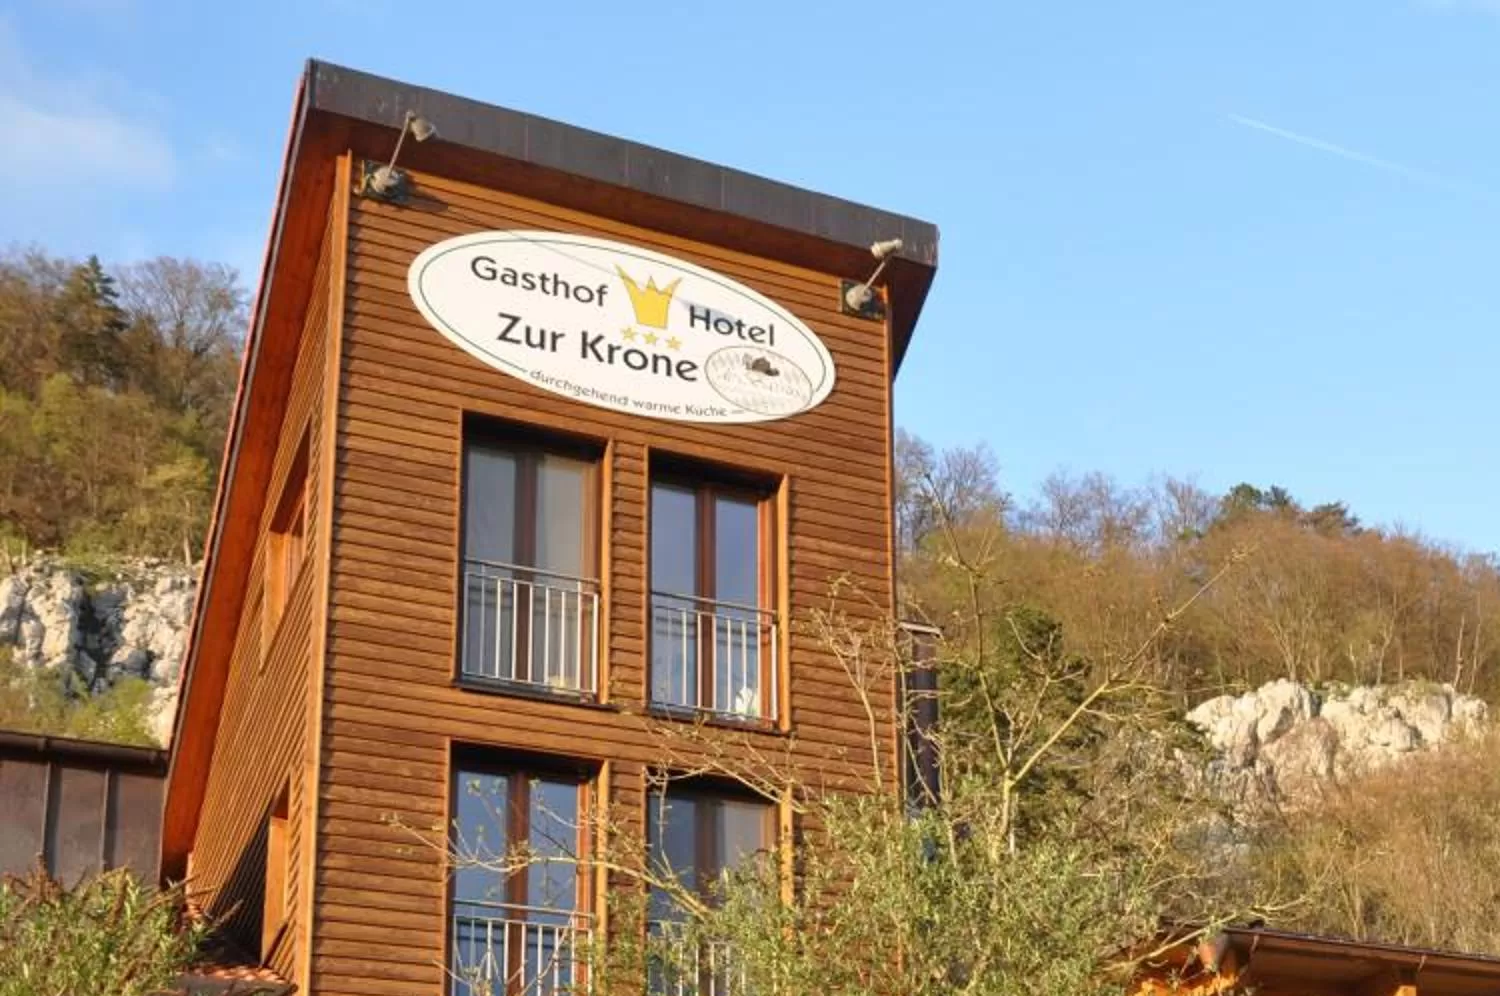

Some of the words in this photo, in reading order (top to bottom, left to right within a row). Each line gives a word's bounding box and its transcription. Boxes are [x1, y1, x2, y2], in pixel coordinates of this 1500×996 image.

[471, 255, 608, 306] Gasthof
[690, 305, 775, 347] Hotel
[496, 312, 566, 353] Zur
[580, 330, 699, 382] Krone
[530, 367, 629, 406] durchgehend
[632, 399, 681, 415] warme
